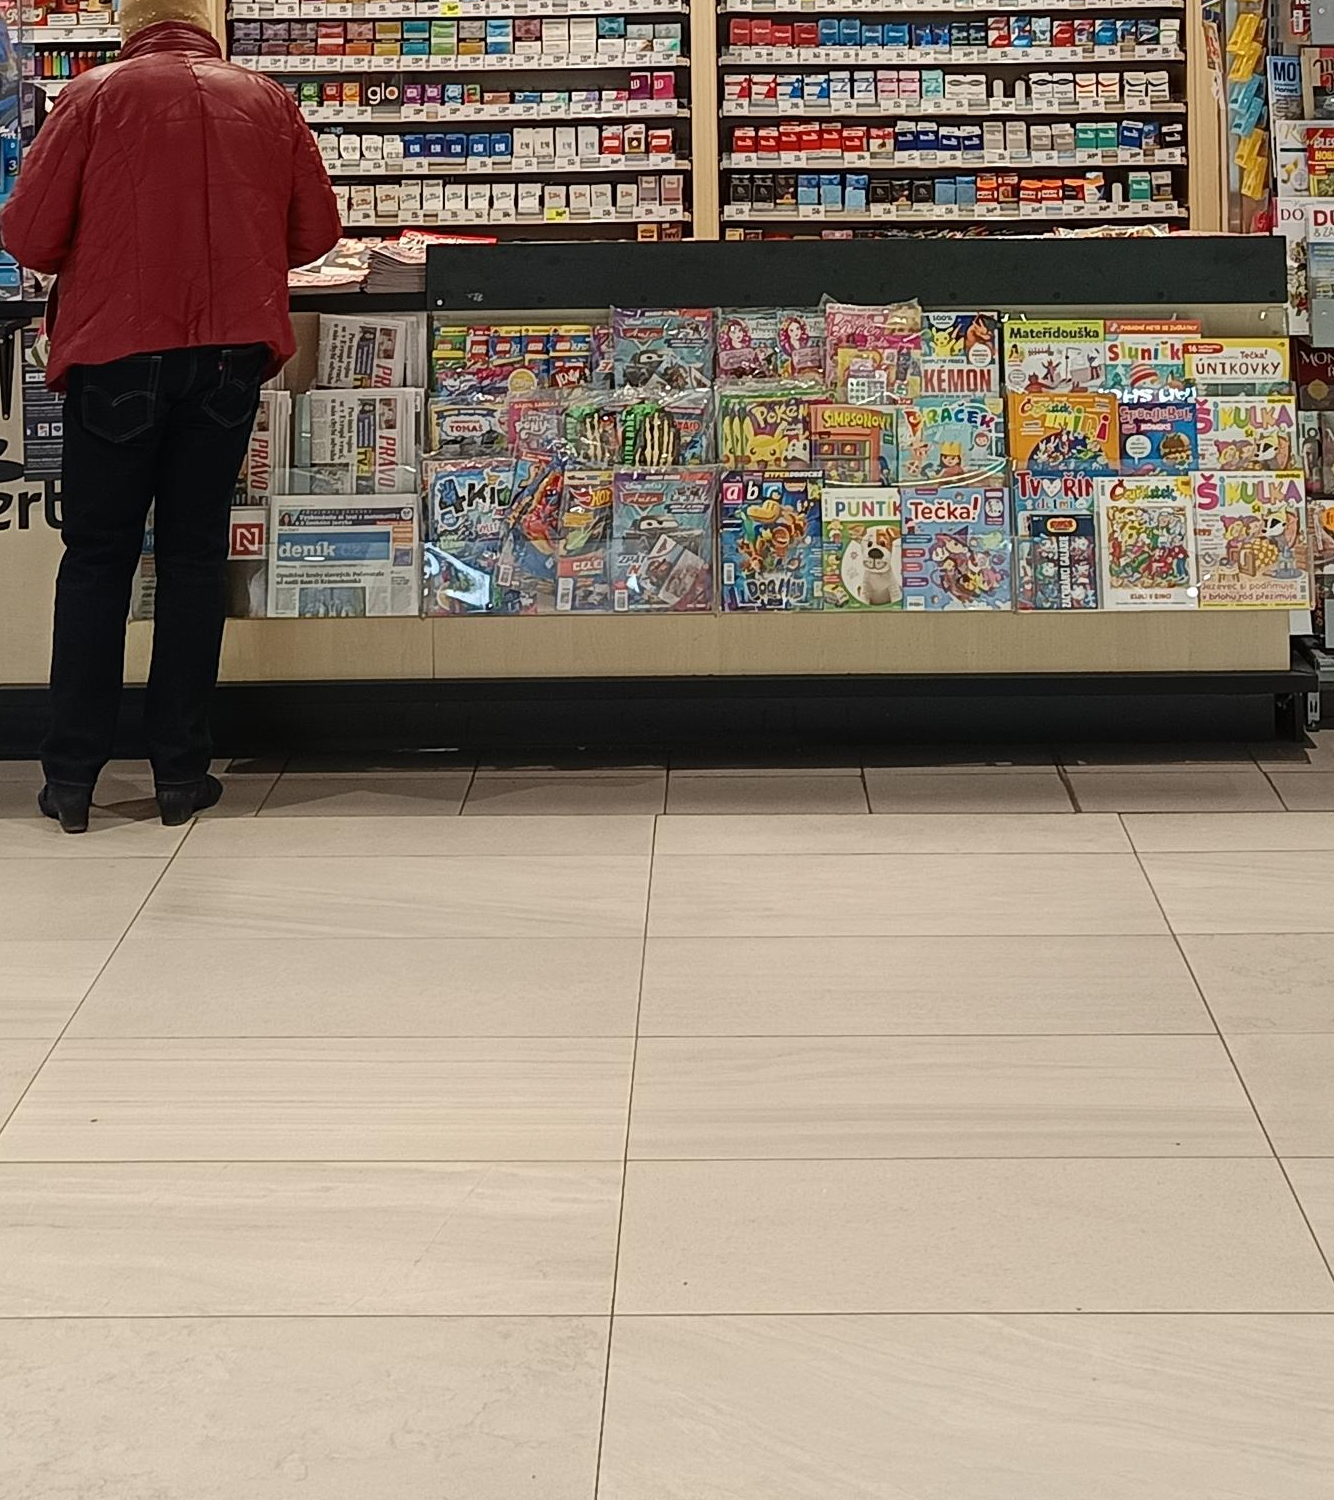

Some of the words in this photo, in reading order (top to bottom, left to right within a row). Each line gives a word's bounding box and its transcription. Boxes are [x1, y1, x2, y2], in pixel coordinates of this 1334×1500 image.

[367, 81, 399, 105] glo
[1009, 327, 1100, 341] Mateřídouška
[1195, 357, 1280, 376] ÚNIKOVKY
[1240, 349, 1267, 360] Tečka!
[1197, 399, 1294, 435] ŠIKULKA
[251, 438, 271, 490] PRÁVO
[378, 434, 397, 489] PRÁVO
[1197, 473, 1302, 510] ŠIKULKA
[835, 492, 901, 518] PUNTÍK
[909, 497, 980, 523] Tečka!
[279, 542, 336, 558] deník
